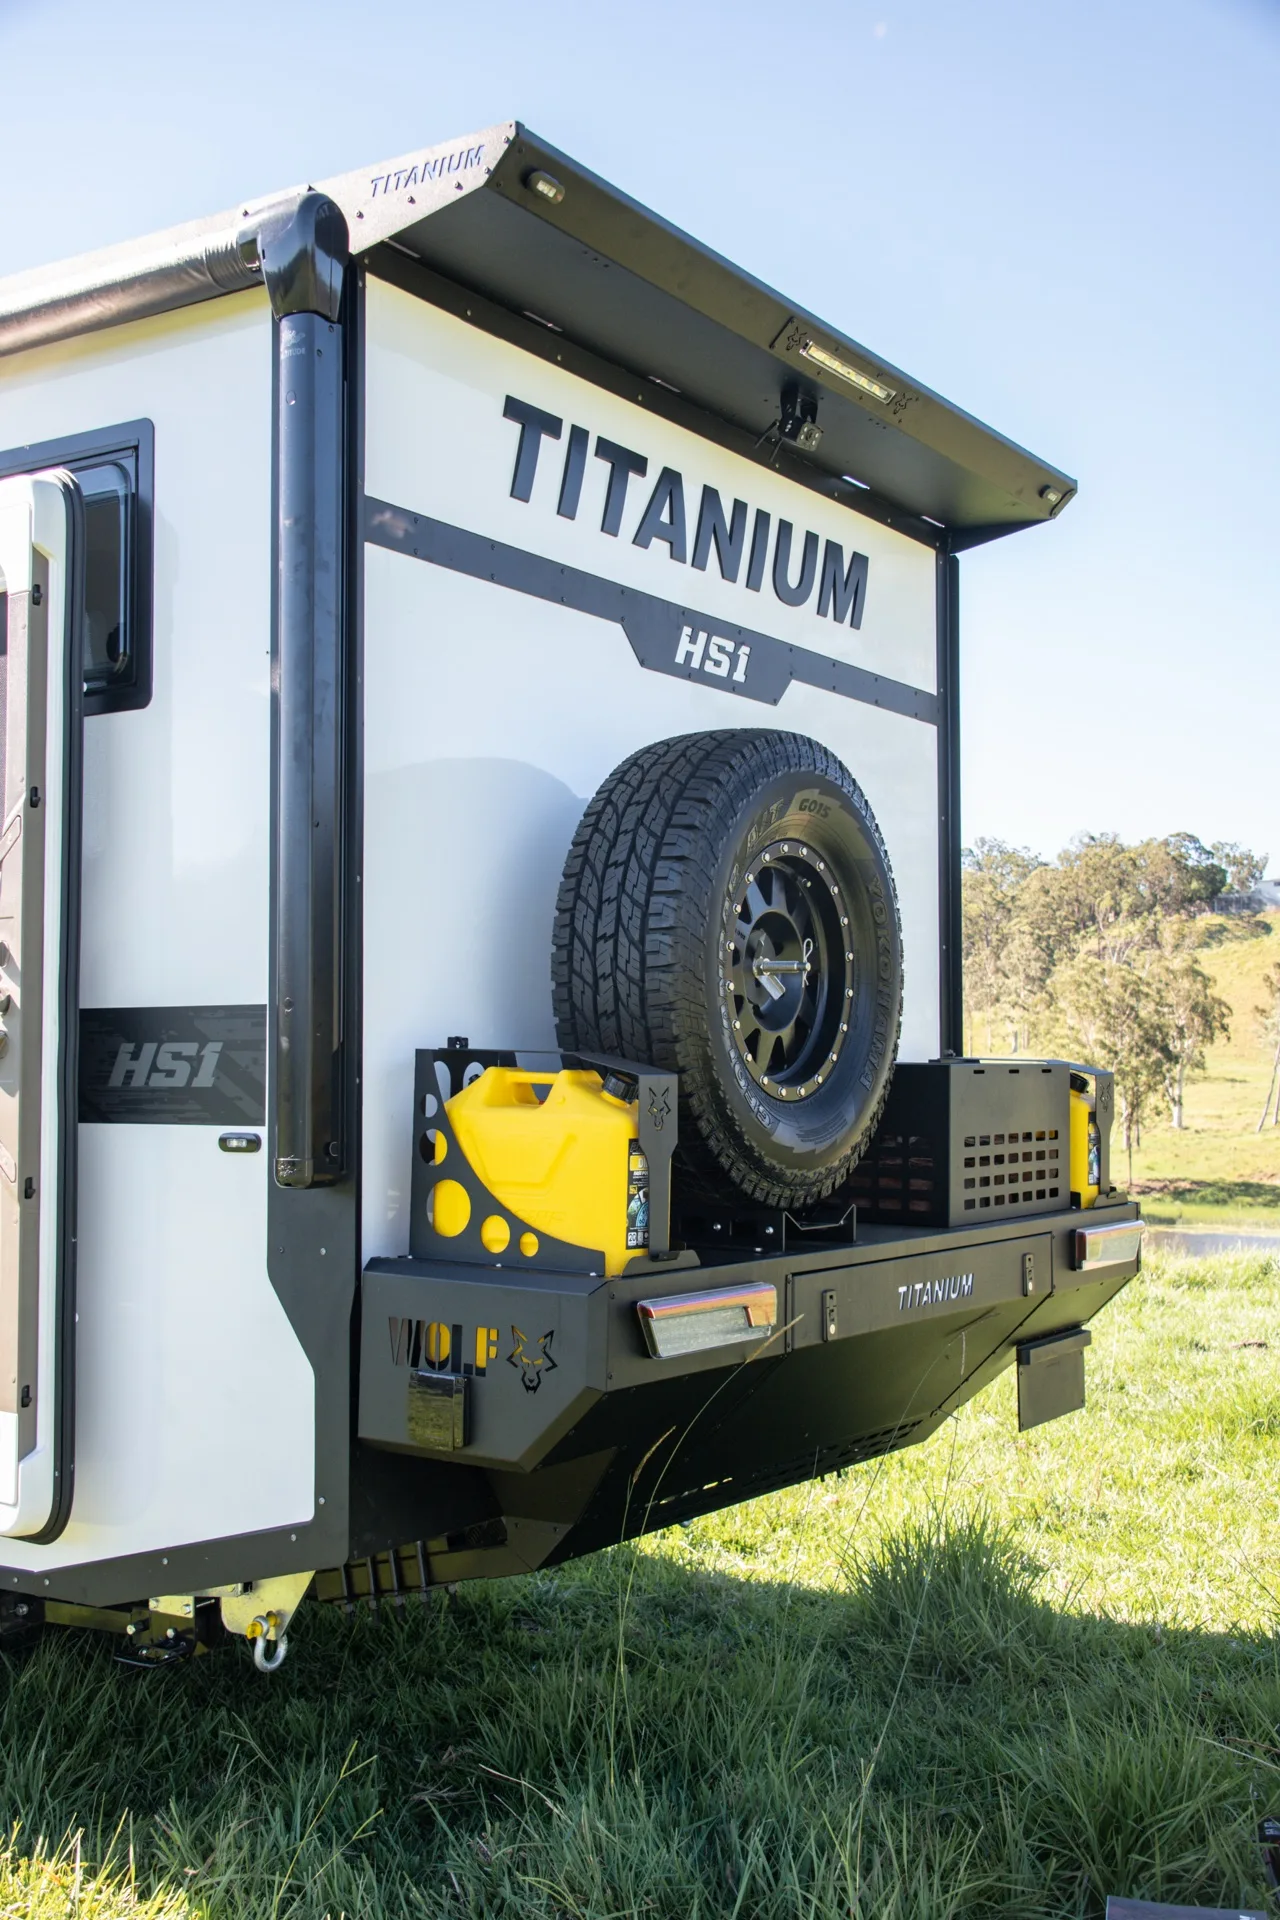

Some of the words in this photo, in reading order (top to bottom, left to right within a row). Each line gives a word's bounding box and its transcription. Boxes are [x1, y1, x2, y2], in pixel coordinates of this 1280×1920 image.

[371, 144, 485, 197] TITANIUM
[502, 394, 870, 631] TITANIUM
[859, 873, 893, 1093] YOKOHAMA
[898, 1273, 975, 1310] TITANIUM
[388, 1316, 499, 1377] WOLF
